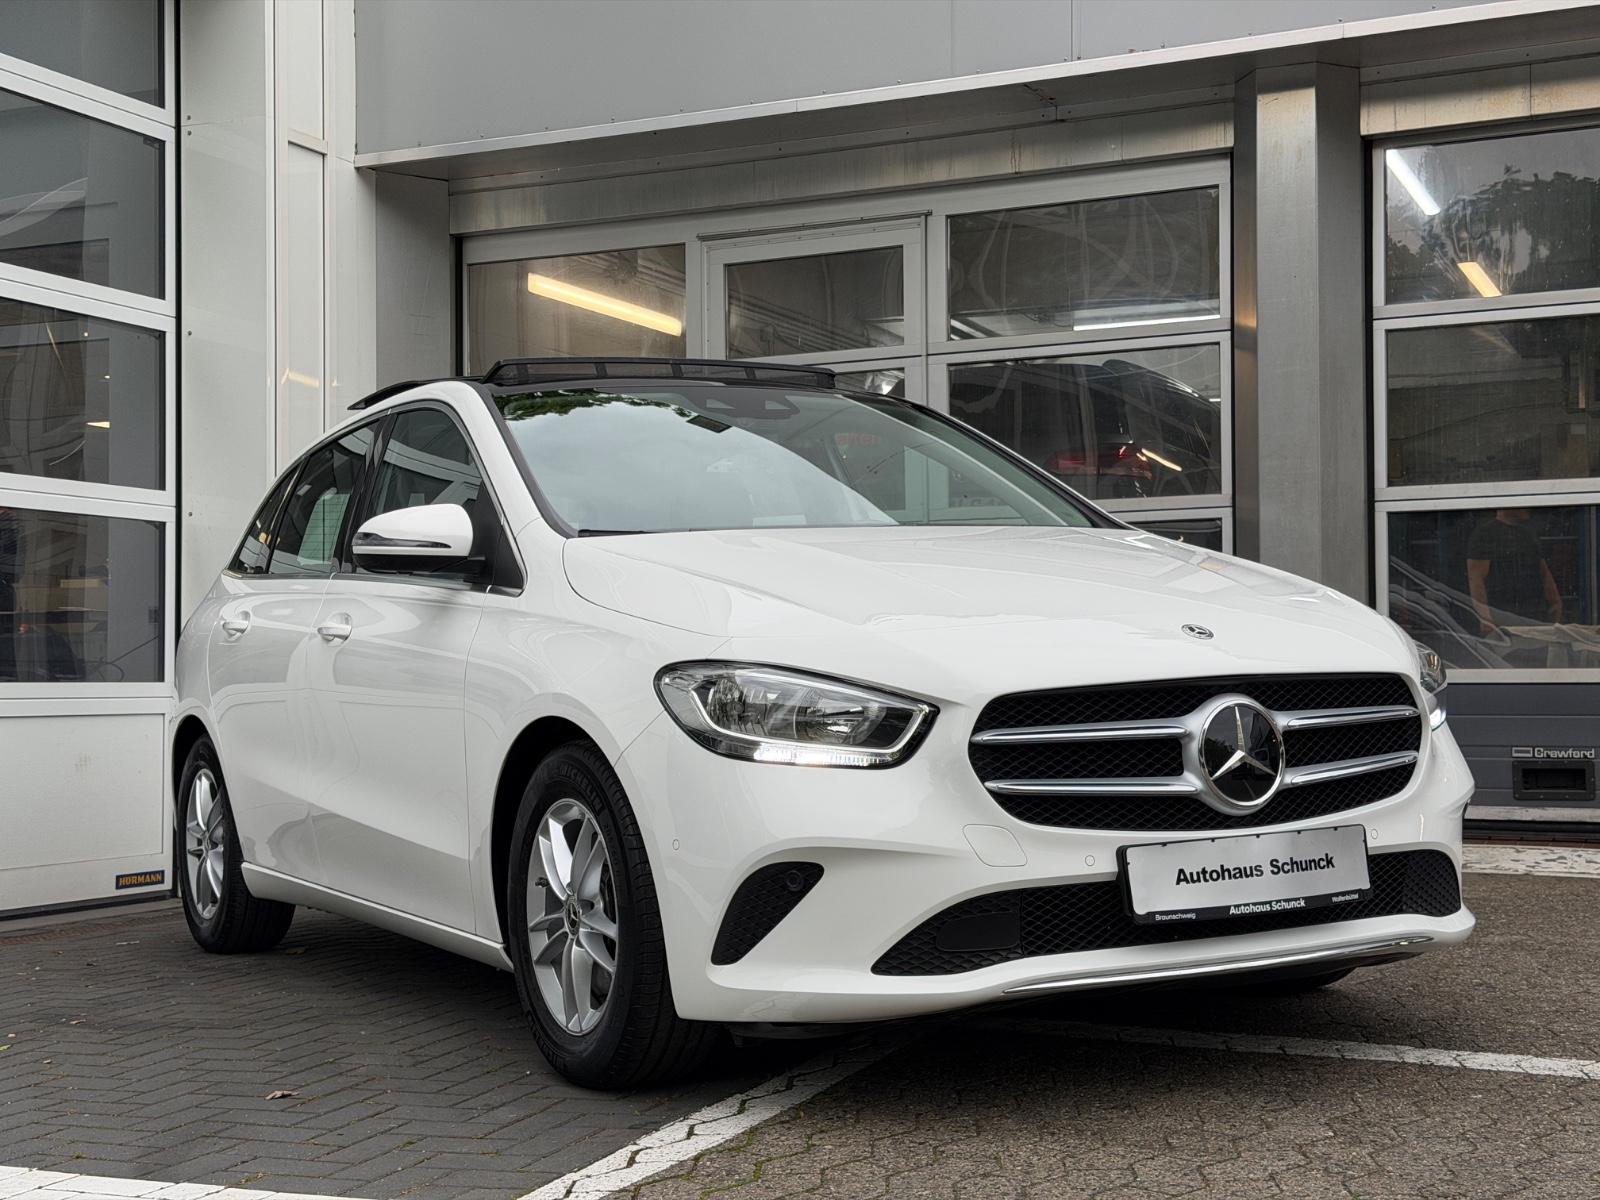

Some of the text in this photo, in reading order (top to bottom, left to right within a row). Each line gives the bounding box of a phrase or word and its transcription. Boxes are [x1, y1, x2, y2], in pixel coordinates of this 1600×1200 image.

[1535, 747, 1595, 758] Crawford
[1175, 853, 1336, 886] Autohaus Schunck
[1229, 898, 1306, 915] Autohaus Schunck
